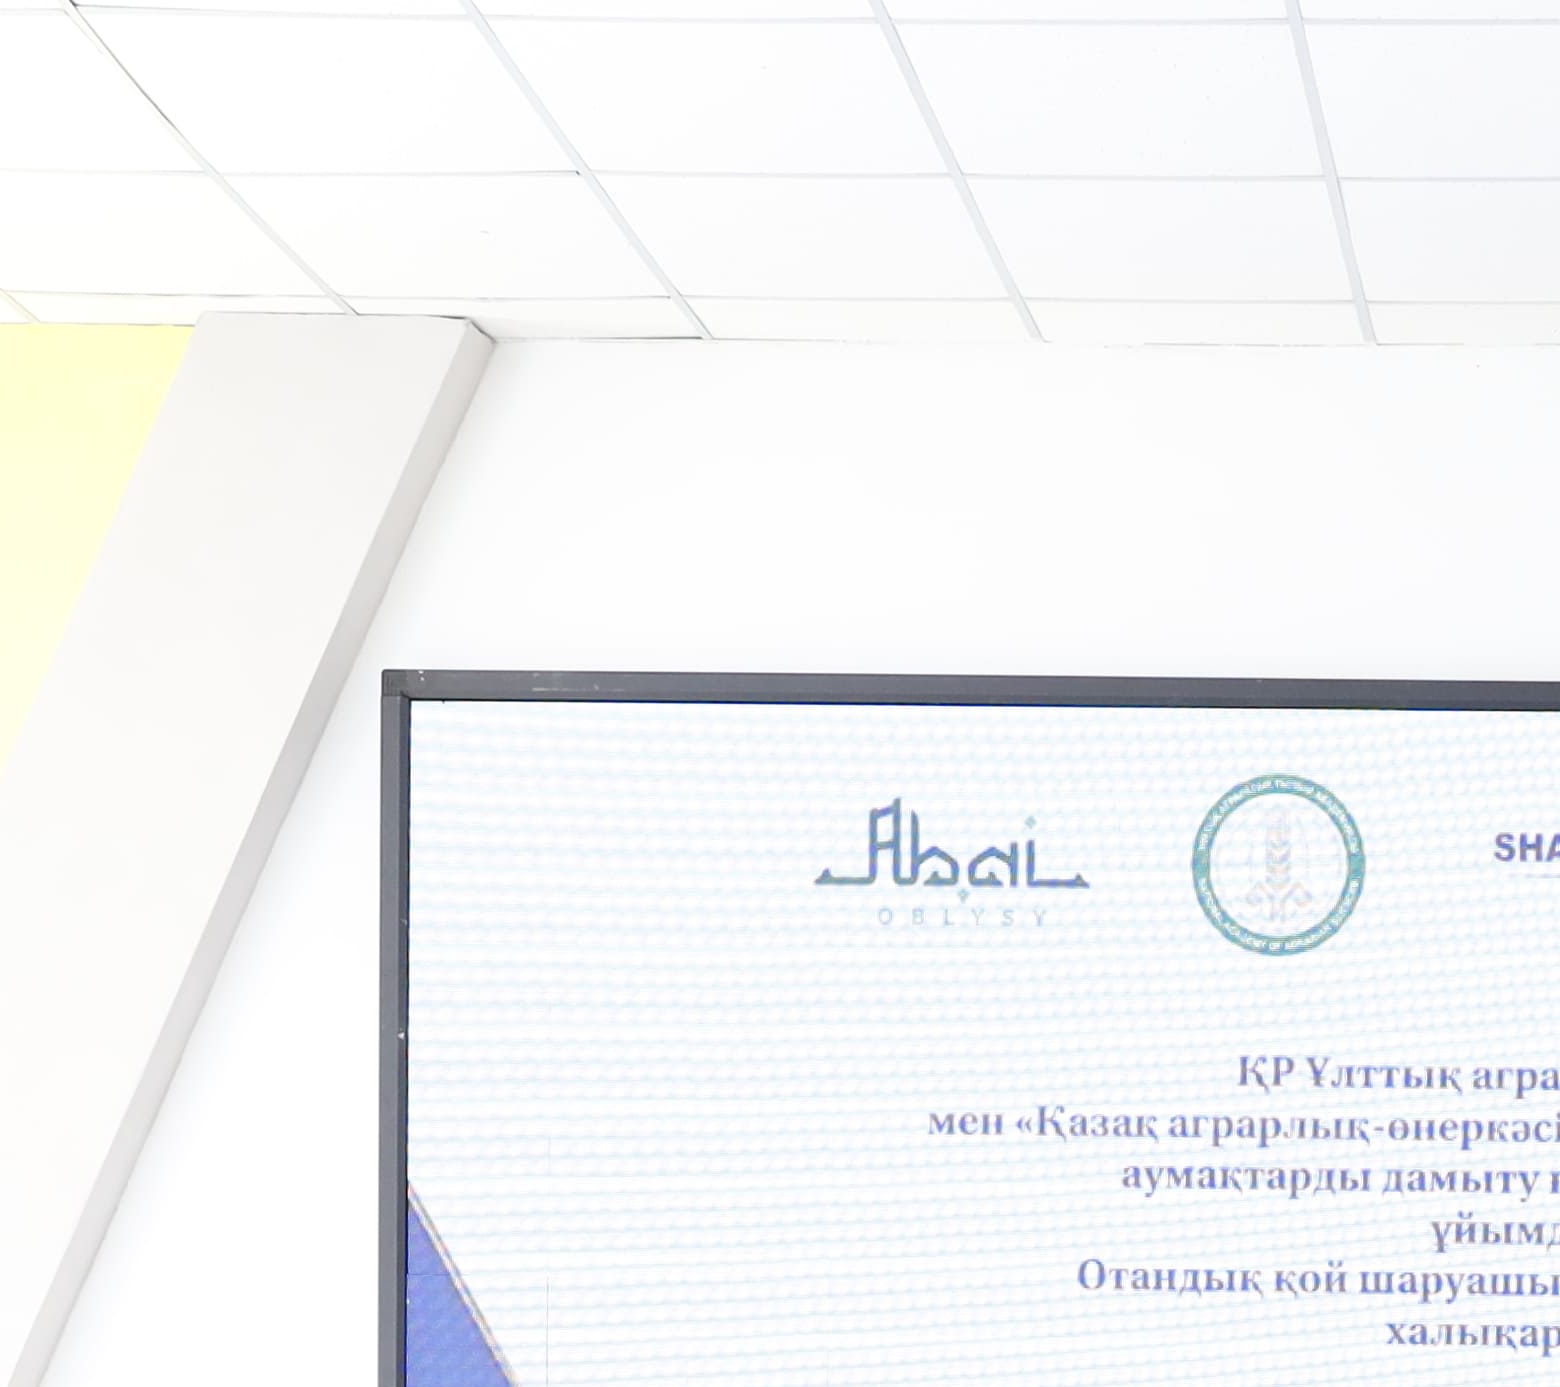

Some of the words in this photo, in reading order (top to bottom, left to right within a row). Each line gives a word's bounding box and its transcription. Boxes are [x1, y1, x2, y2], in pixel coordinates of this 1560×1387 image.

[1239, 1055, 1294, 1092] ҚР
[1307, 1056, 1462, 1093] Ұлттық
[928, 1113, 1004, 1136] мен
[1016, 1105, 1159, 1141] «Қазақ
[1122, 1165, 1371, 1200] аумақтарды
[1382, 1169, 1540, 1200] дамыту
[1078, 1258, 1263, 1294] Отандық
[1275, 1259, 1348, 1294] қой
